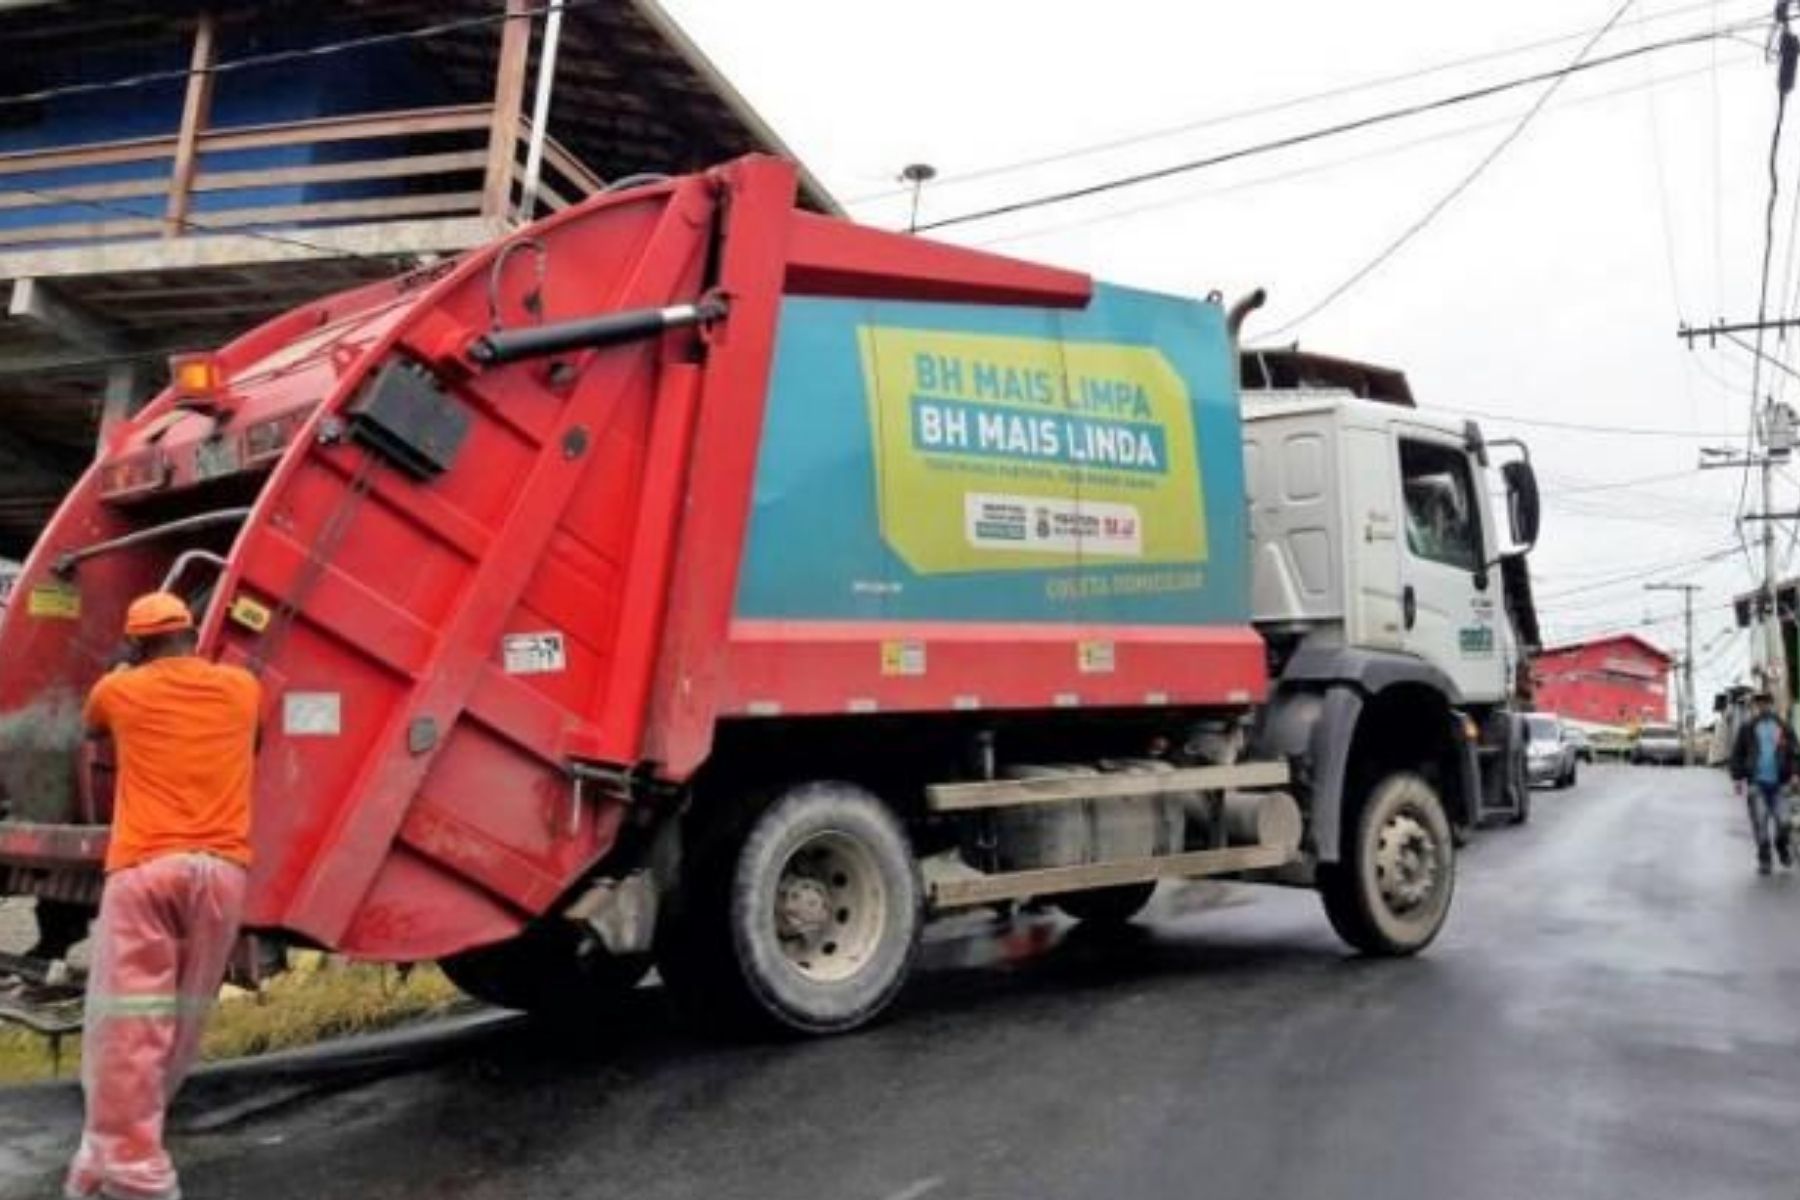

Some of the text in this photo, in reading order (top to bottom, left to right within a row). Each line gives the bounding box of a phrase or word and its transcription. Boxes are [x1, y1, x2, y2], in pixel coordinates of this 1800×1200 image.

[916, 353, 1153, 417] BH MAIS LIMPA
[919, 405, 1156, 467] BH MAIS LINDA
